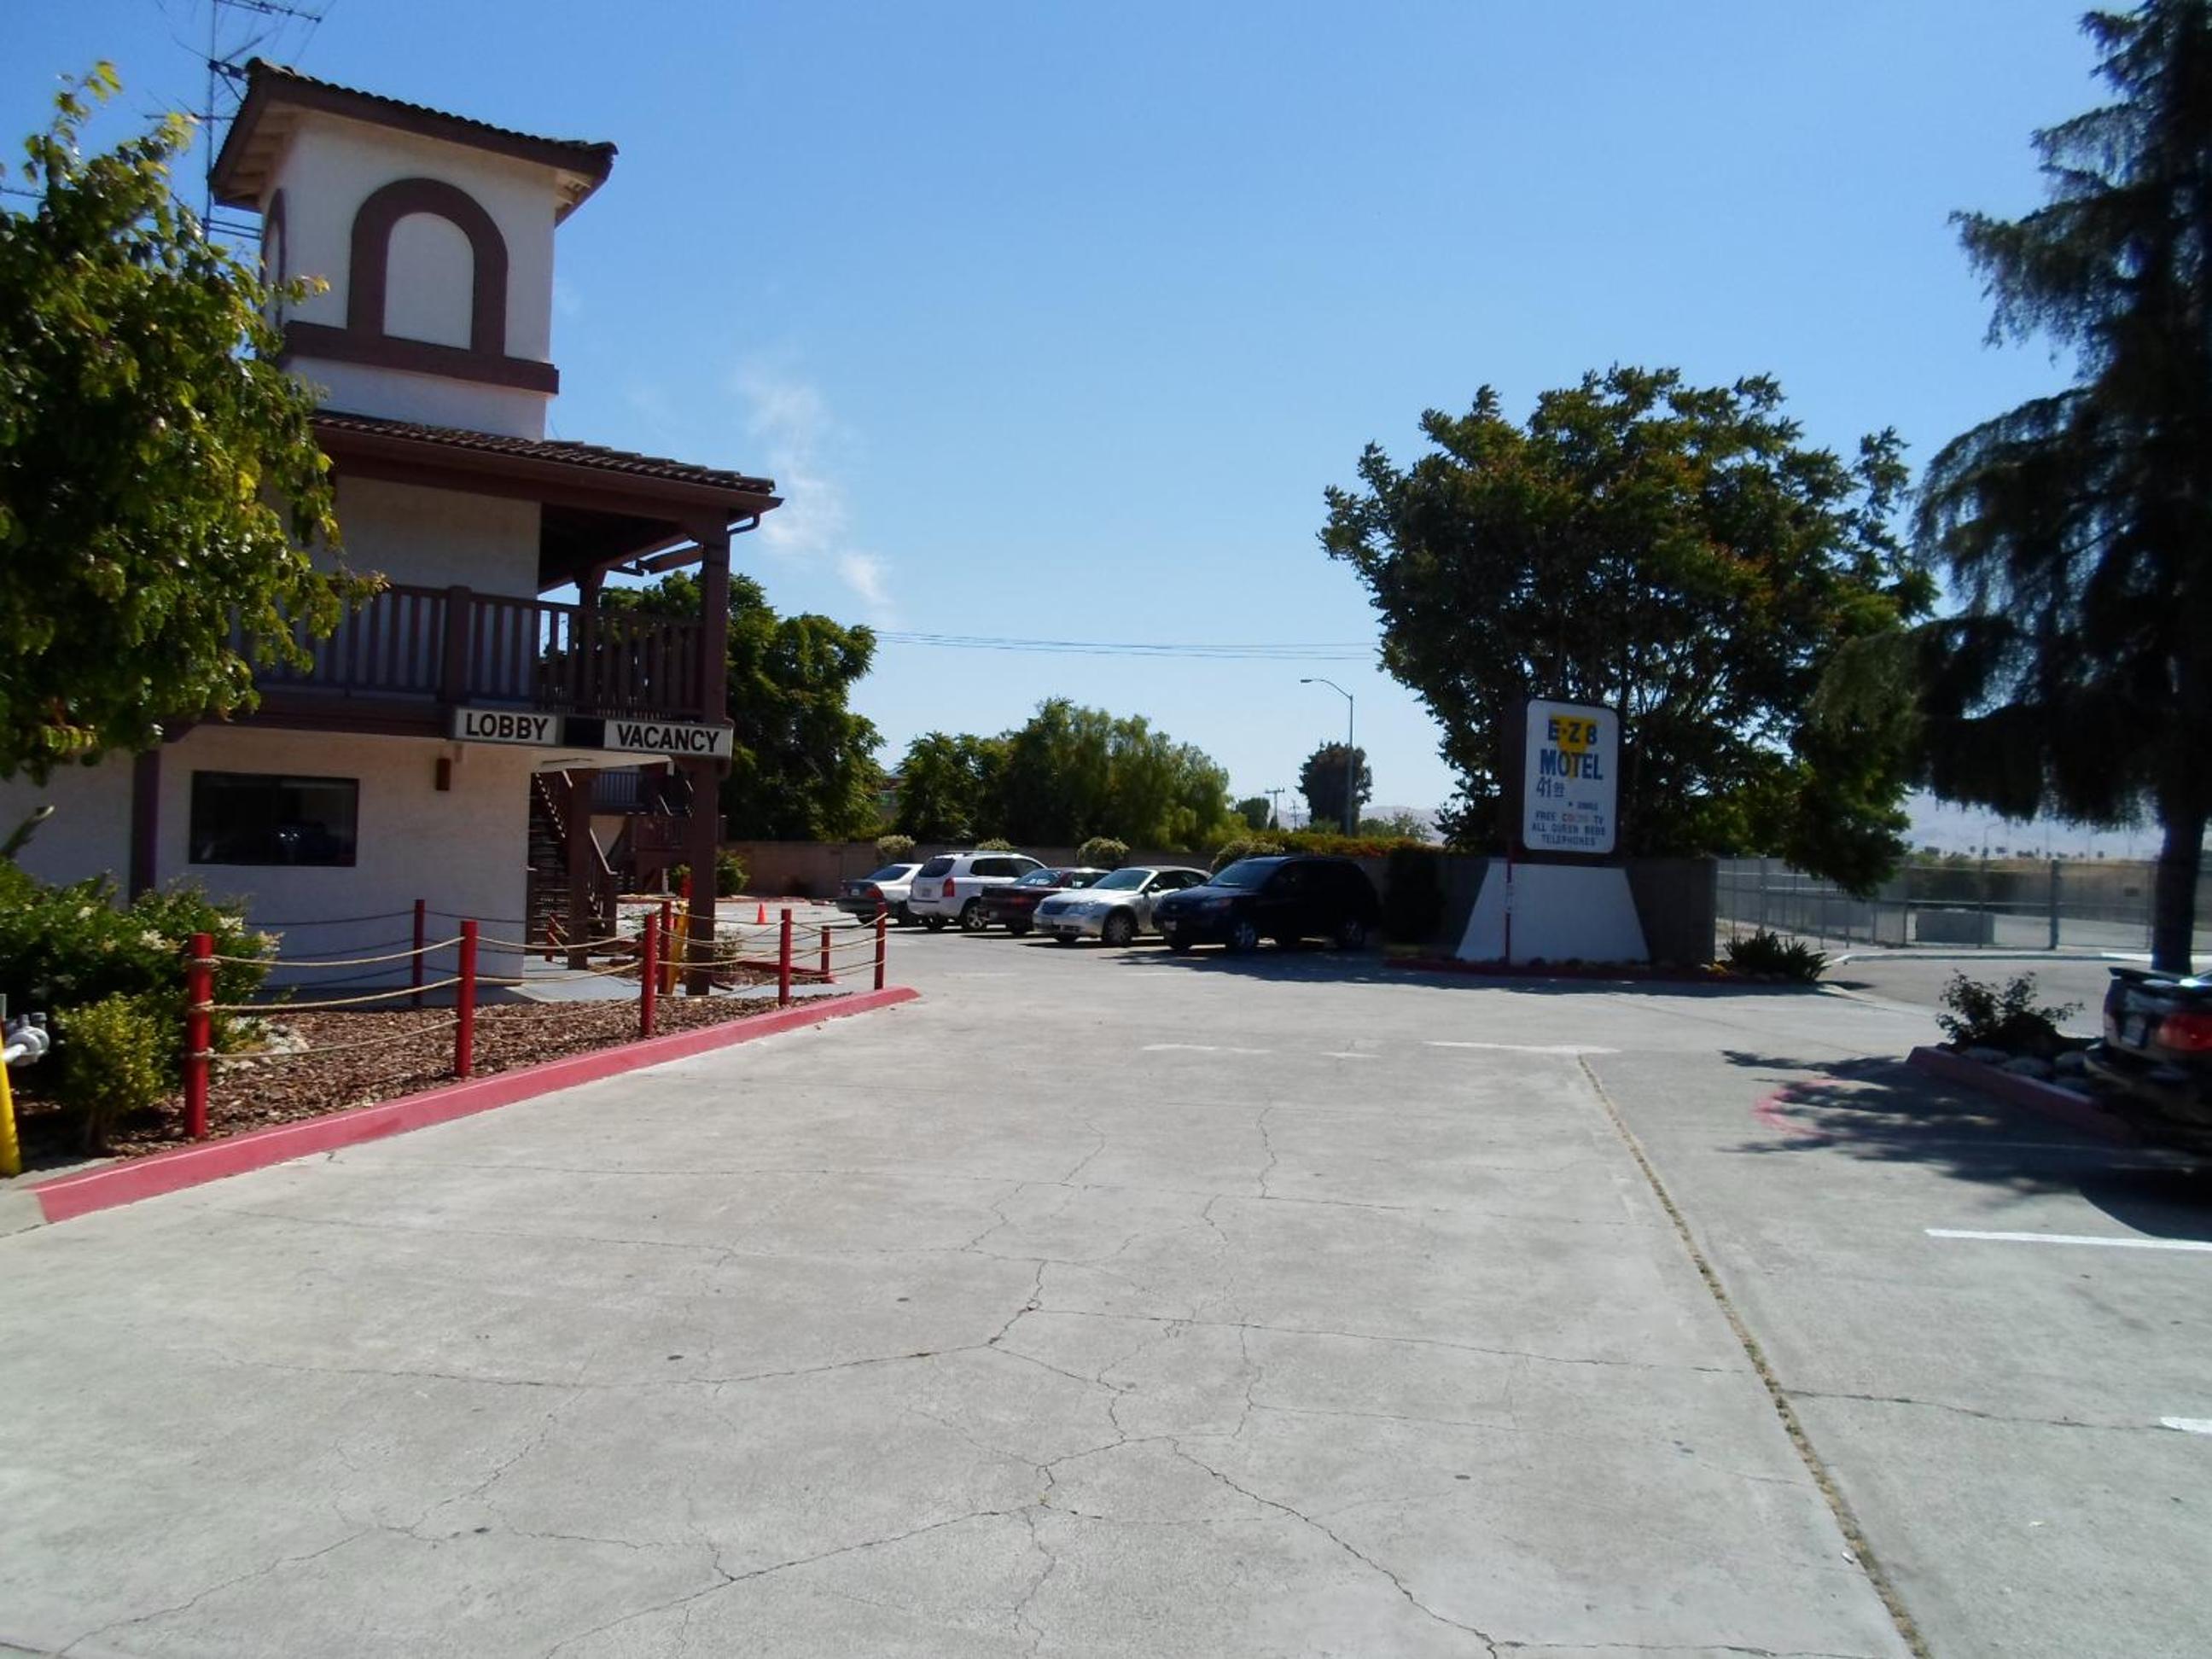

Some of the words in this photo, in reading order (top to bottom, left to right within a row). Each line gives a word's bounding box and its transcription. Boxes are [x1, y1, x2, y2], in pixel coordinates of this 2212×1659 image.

[466, 713, 548, 741] LOBBY
[1586, 724, 1598, 745] 8
[617, 724, 720, 753] VACANCY
[1540, 749, 1604, 780] MOTEL
[1532, 823, 1545, 832] ALL
[1536, 811, 1557, 821] FREE
[1594, 816, 1604, 826] TV
[1541, 834, 1596, 847] TELEPHONES
